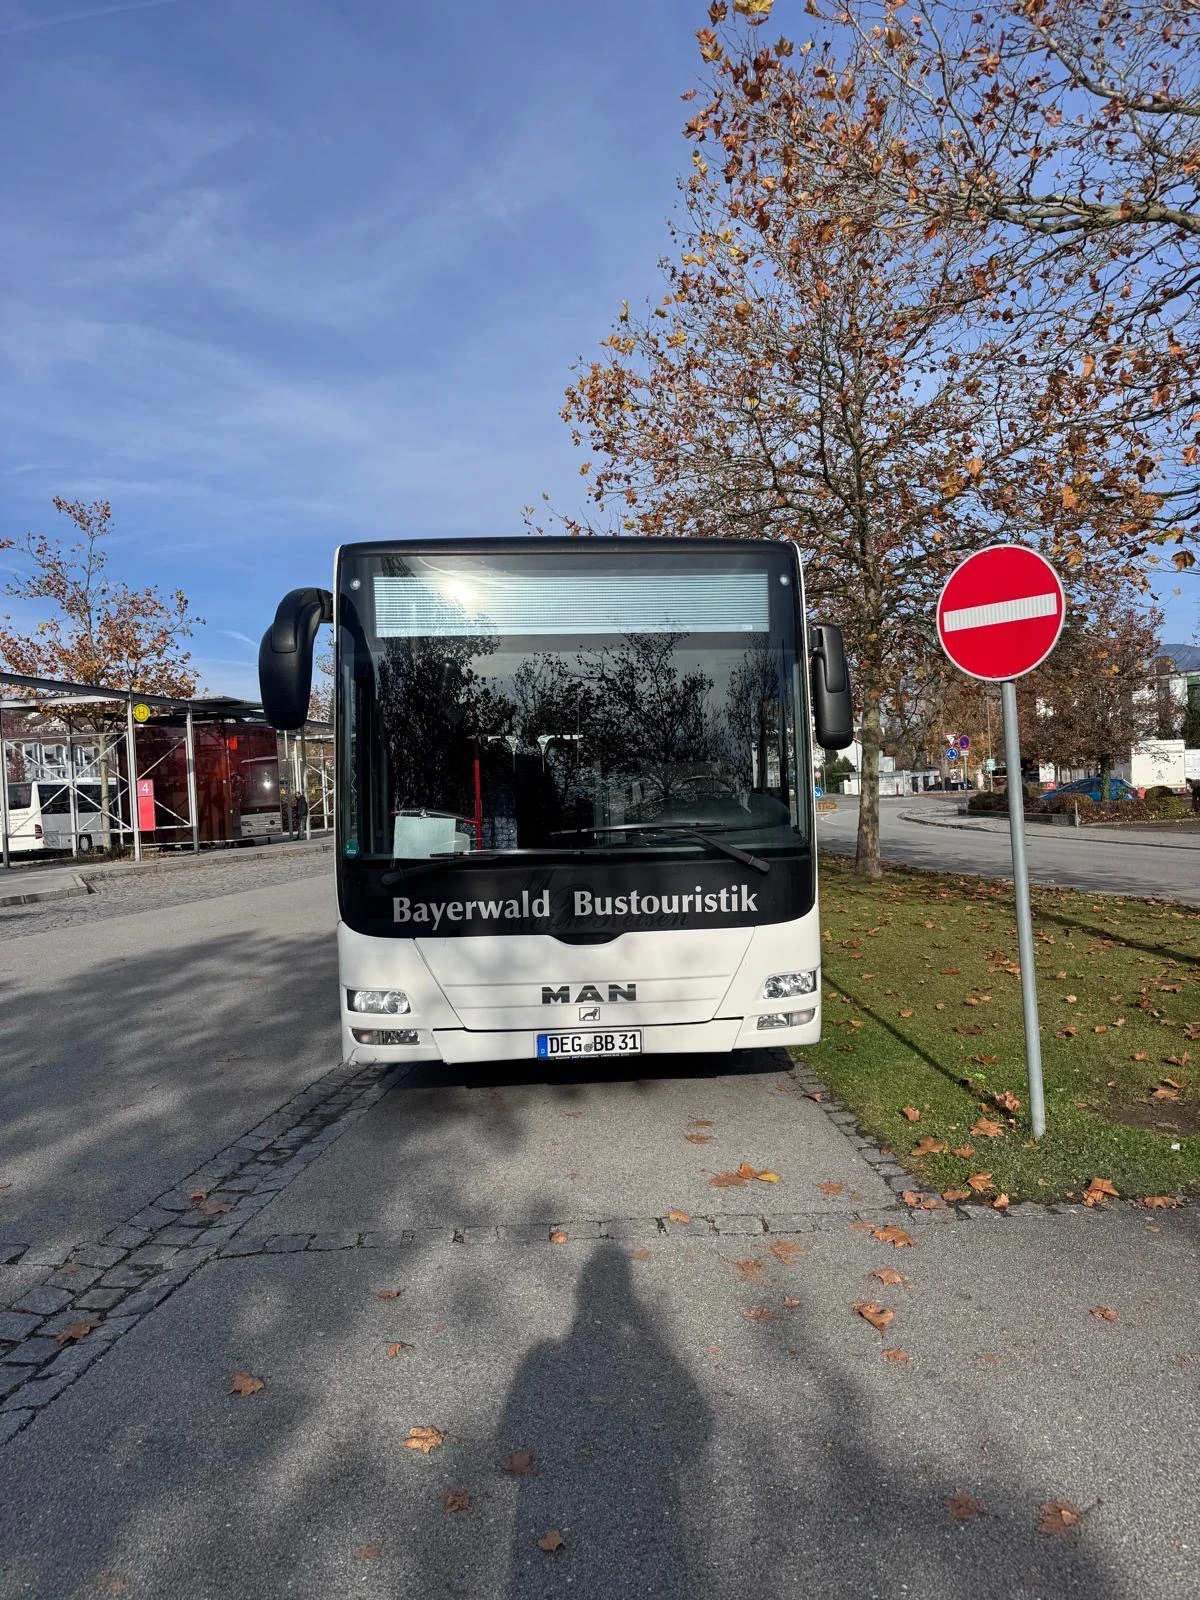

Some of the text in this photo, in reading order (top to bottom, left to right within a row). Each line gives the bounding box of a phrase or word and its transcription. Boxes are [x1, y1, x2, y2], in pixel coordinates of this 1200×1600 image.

[142, 783, 149, 794] 4
[393, 889, 550, 931] Bayerwald
[573, 884, 759, 916] Bustouristik
[541, 984, 637, 1005] MAN
[548, 1033, 639, 1054] DEG BB 31
